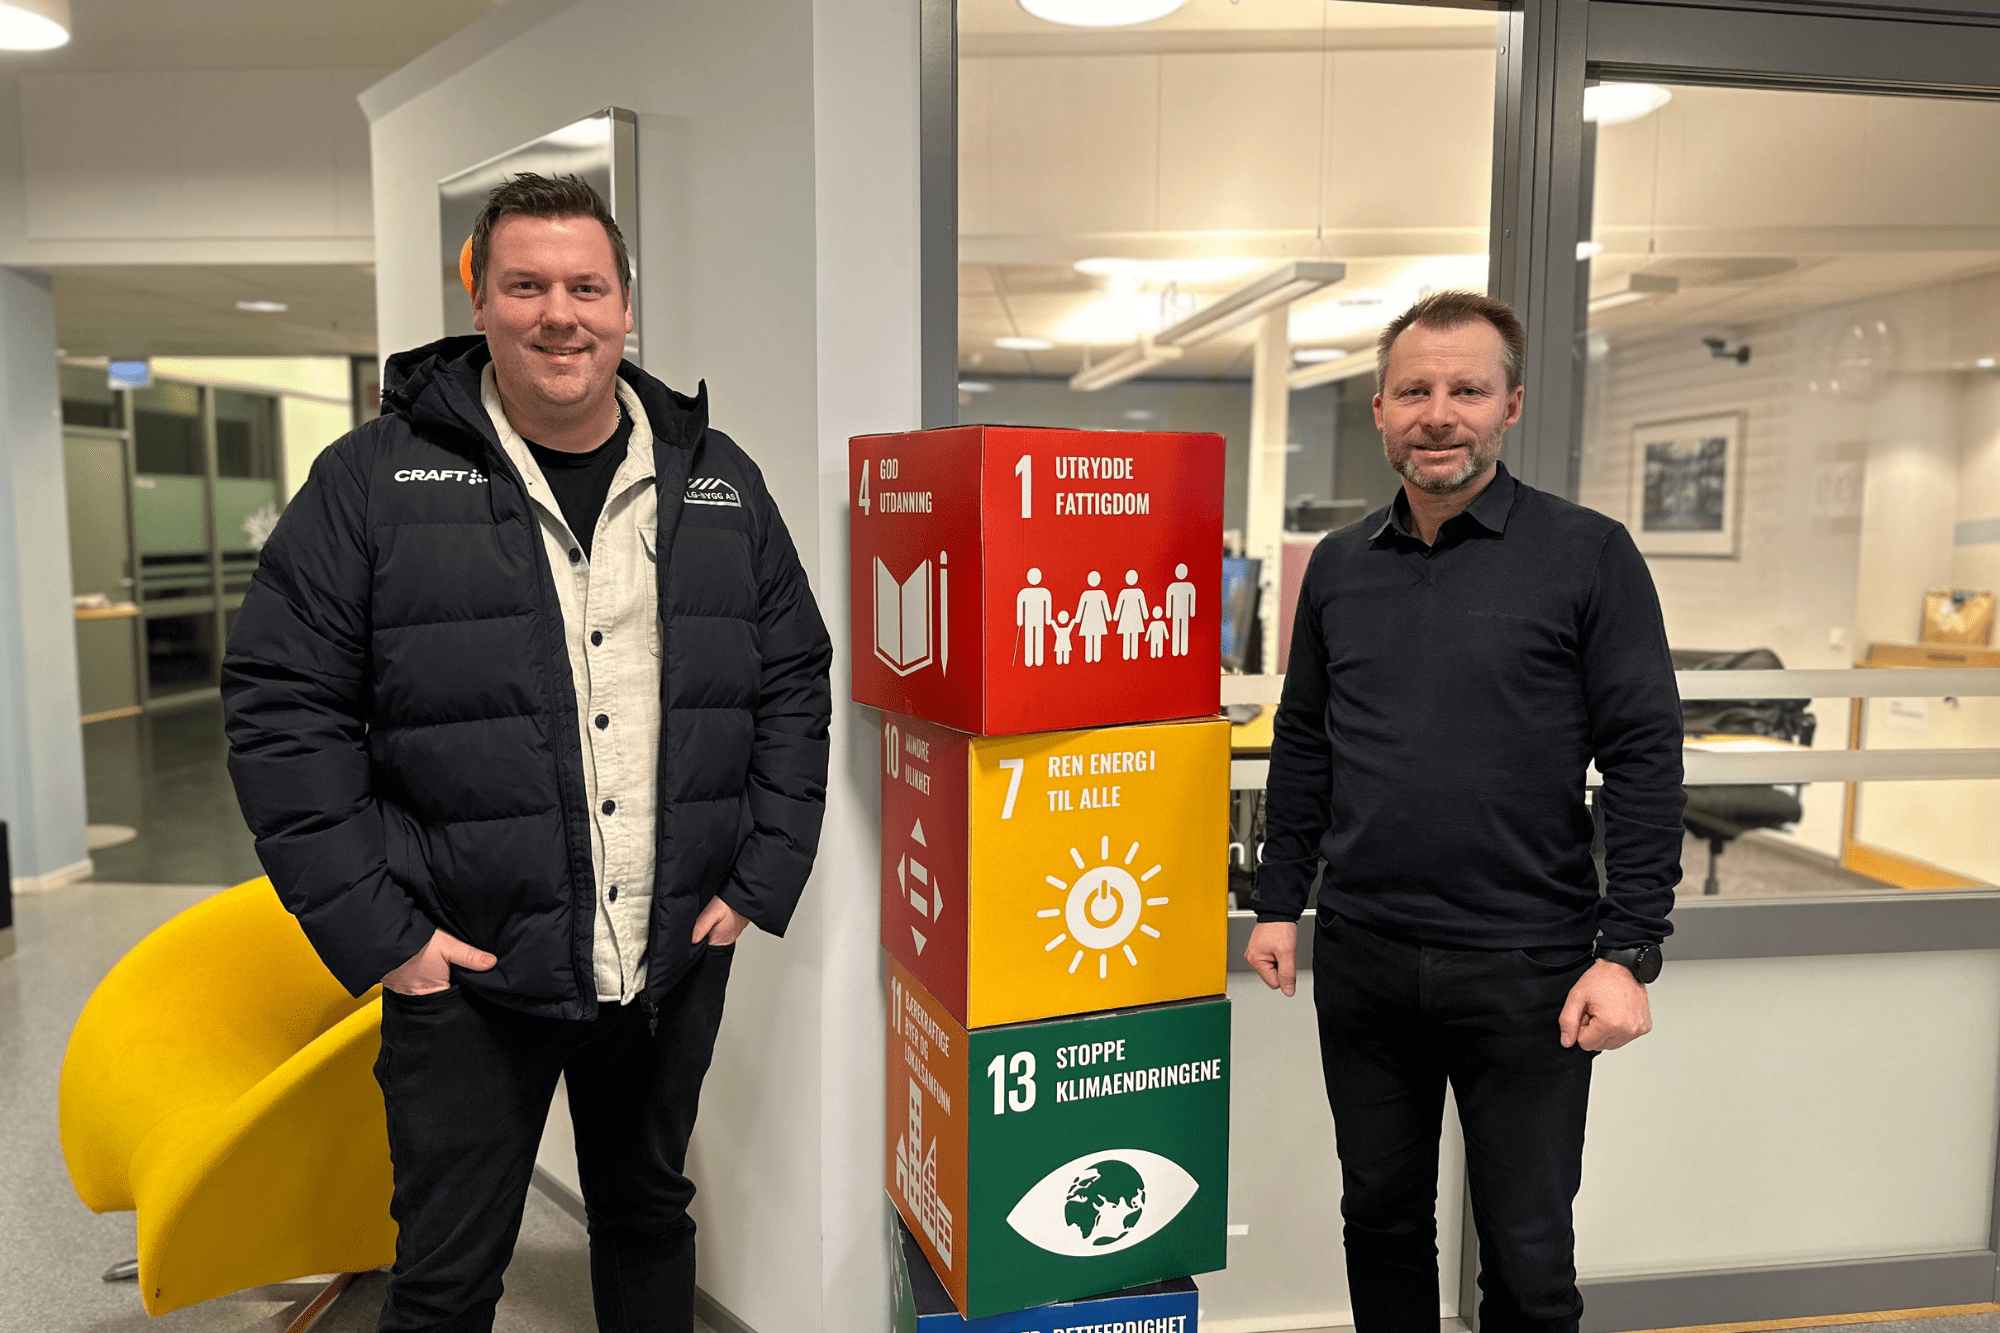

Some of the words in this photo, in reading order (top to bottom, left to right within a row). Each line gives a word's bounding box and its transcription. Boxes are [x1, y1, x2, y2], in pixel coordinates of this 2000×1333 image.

[394, 469, 469, 482] CRAFT
[880, 458, 898, 480] GOD
[1055, 456, 1134, 480] UTRYDDE
[686, 491, 724, 500] LG-BYGG
[725, 493, 737, 501] AS
[858, 460, 871, 516] 4
[880, 491, 933, 514] UTDANNING
[1014, 454, 1032, 519] 1
[1055, 492, 1150, 515] FATTIGDOM
[884, 722, 899, 779] 10
[905, 732, 930, 764] MINDRE
[1048, 755, 1084, 778] REN
[1090, 750, 1156, 775] ENERGI
[905, 763, 931, 797] ULIKHET
[999, 758, 1024, 820] 7
[1047, 789, 1074, 812] TIL
[1079, 785, 1121, 809] ALLE
[891, 975, 902, 1035] 11
[905, 989, 950, 1058] BÆREKRAFTIGE
[905, 1015, 919, 1050] BYER
[920, 1034, 929, 1062] OG
[1056, 1039, 1126, 1070] STOPPE
[904, 1041, 951, 1117] LOKALSAMFUNN
[987, 1051, 1037, 1116] 13
[1056, 1059, 1222, 1103] KLIMAENDRINGENE
